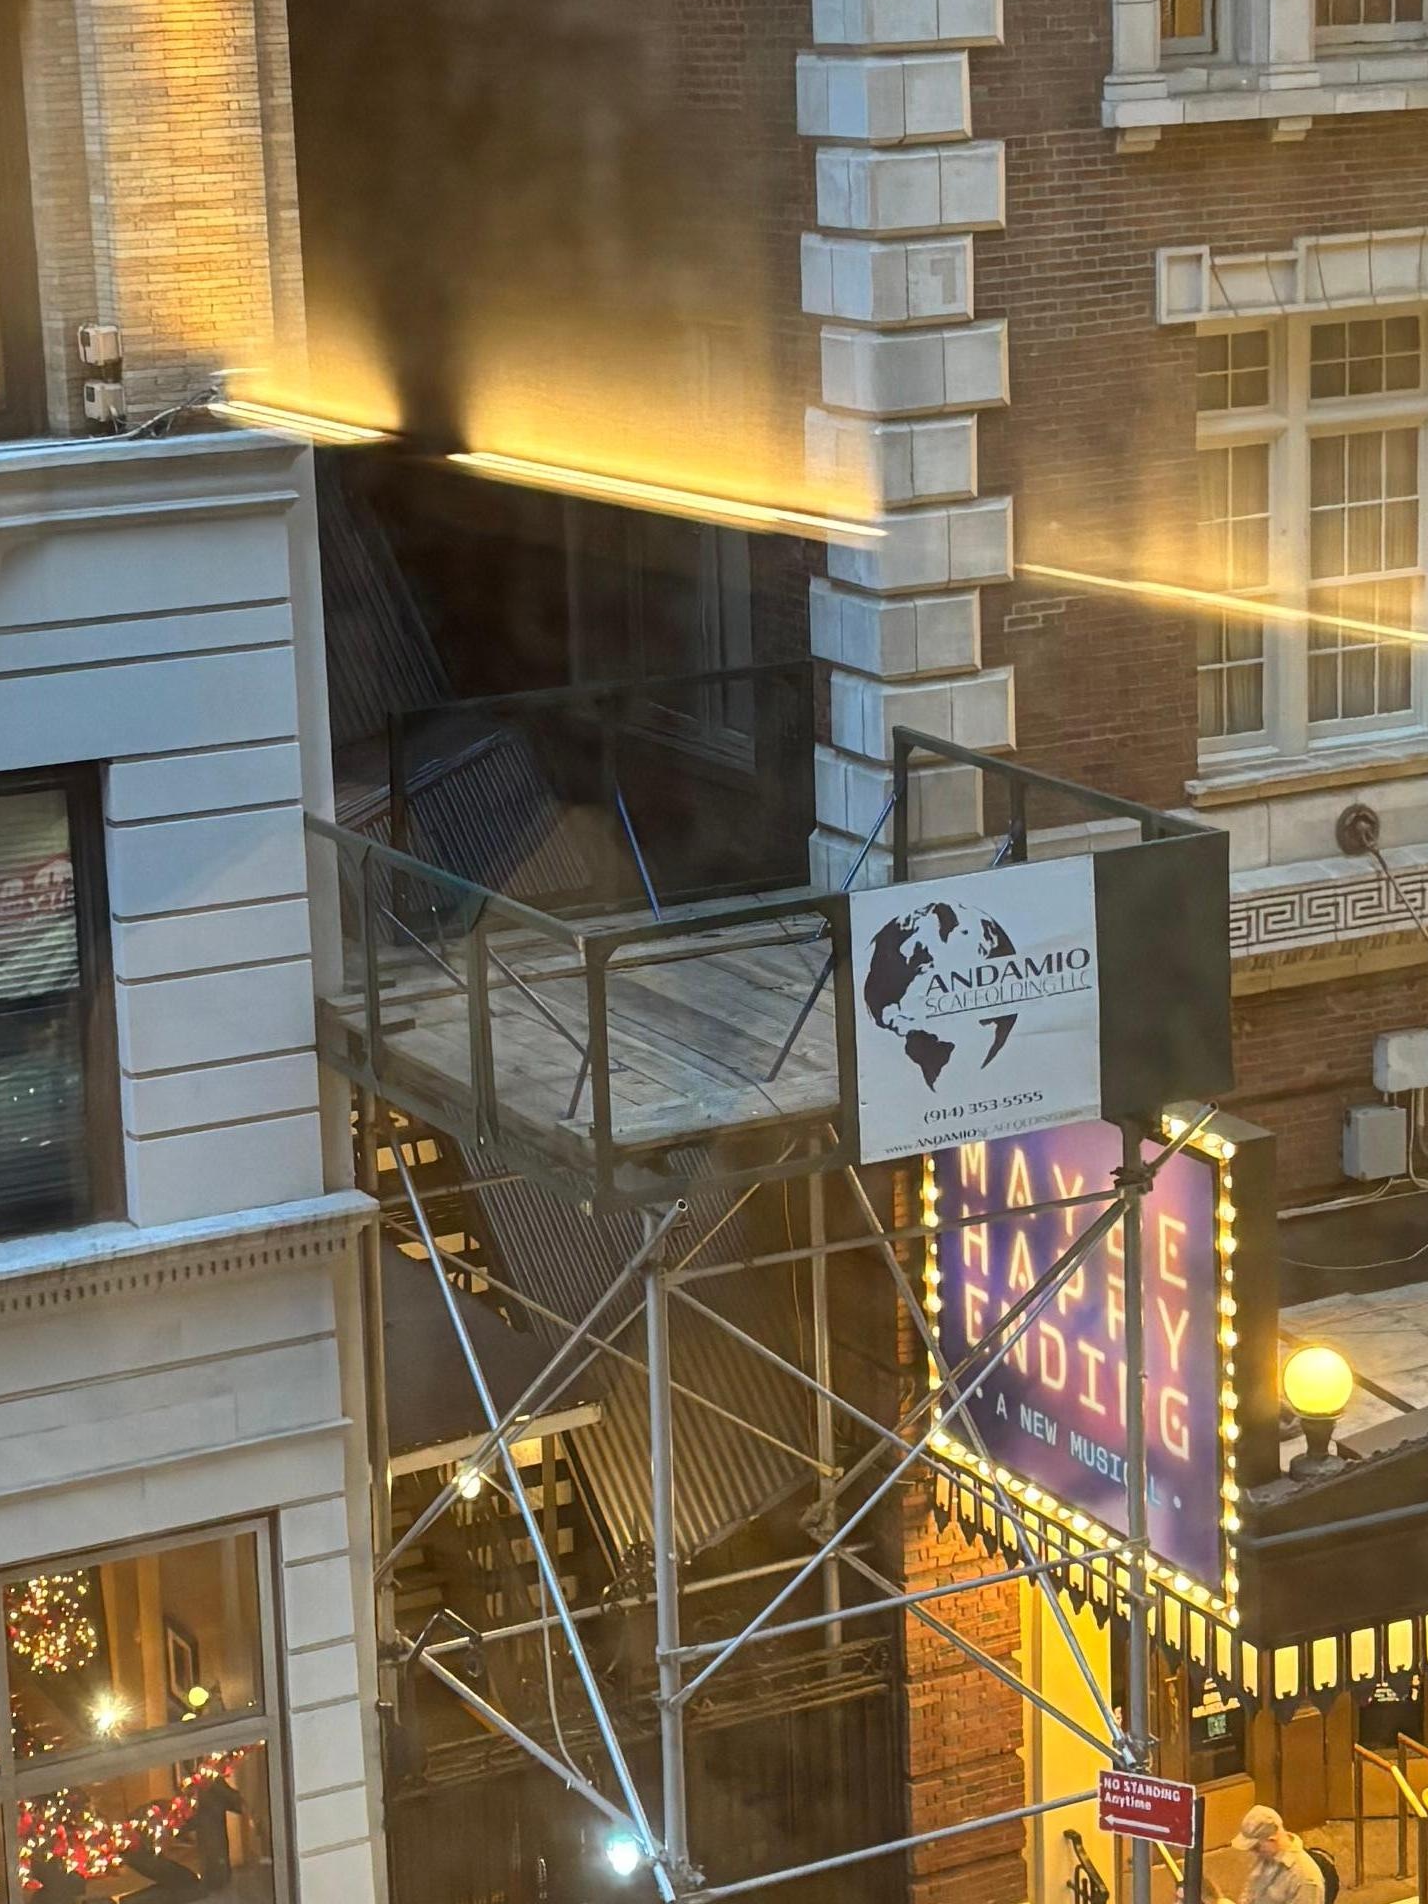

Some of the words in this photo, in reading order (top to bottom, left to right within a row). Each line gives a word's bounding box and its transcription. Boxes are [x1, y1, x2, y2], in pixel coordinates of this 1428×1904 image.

[927, 948, 1090, 997] ANDAMIO
[924, 1105, 964, 1125] (914)
[969, 1091, 1043, 1115] 353-5555
[996, 1392, 1007, 1419] A
[1021, 1404, 1057, 1447] NEW
[1071, 1431, 1161, 1506] MUSIL
[1104, 1778, 1120, 1790] NO
[1124, 1781, 1180, 1802] STANDING
[1105, 1792, 1151, 1810] Anytime
